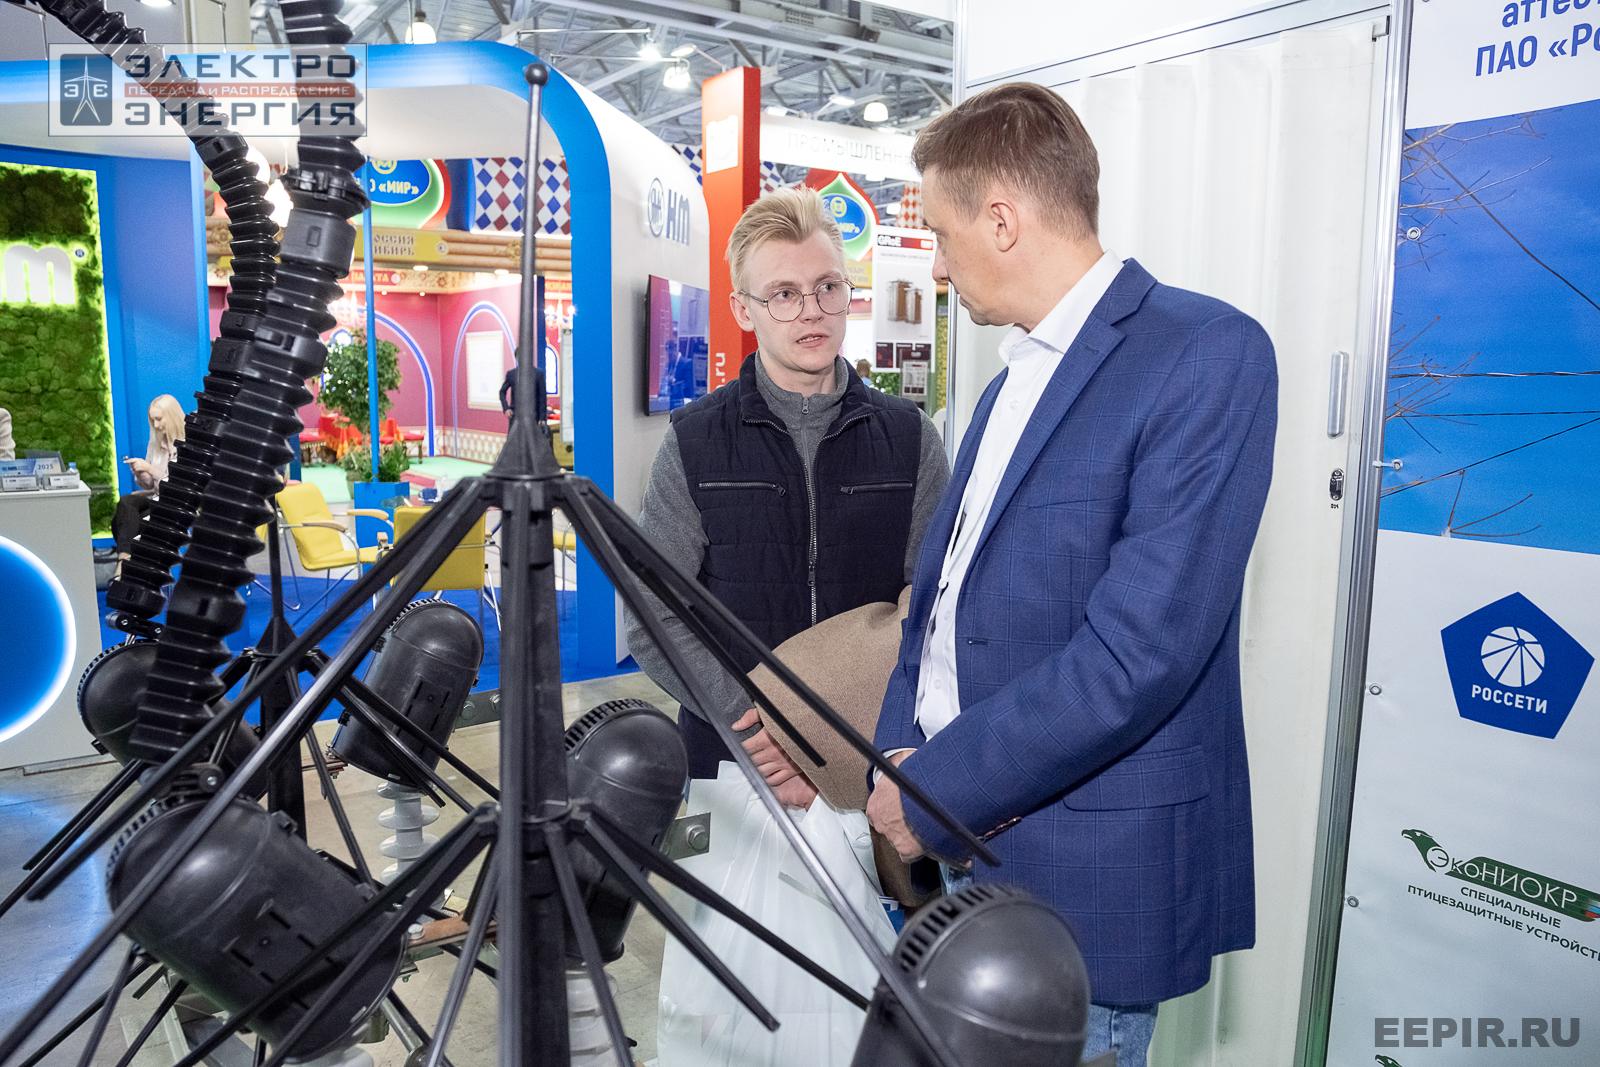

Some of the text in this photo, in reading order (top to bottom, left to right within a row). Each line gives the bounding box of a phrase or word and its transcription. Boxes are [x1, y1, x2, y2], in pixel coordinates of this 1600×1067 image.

[1502, 0, 1600, 27] атте
[1475, 35, 1538, 77] ПАО
[374, 233, 415, 246] ОССИЯ
[374, 245, 416, 257] ИБИРЬ
[715, 352, 726, 389] .ru
[1471, 684, 1548, 714] РОССЕТИ
[1407, 884, 1523, 931] ПТИЦЕЗАЩИТНЫЕ
[1460, 886, 1562, 929] СПЕЦИАЛЬНЫЕ
